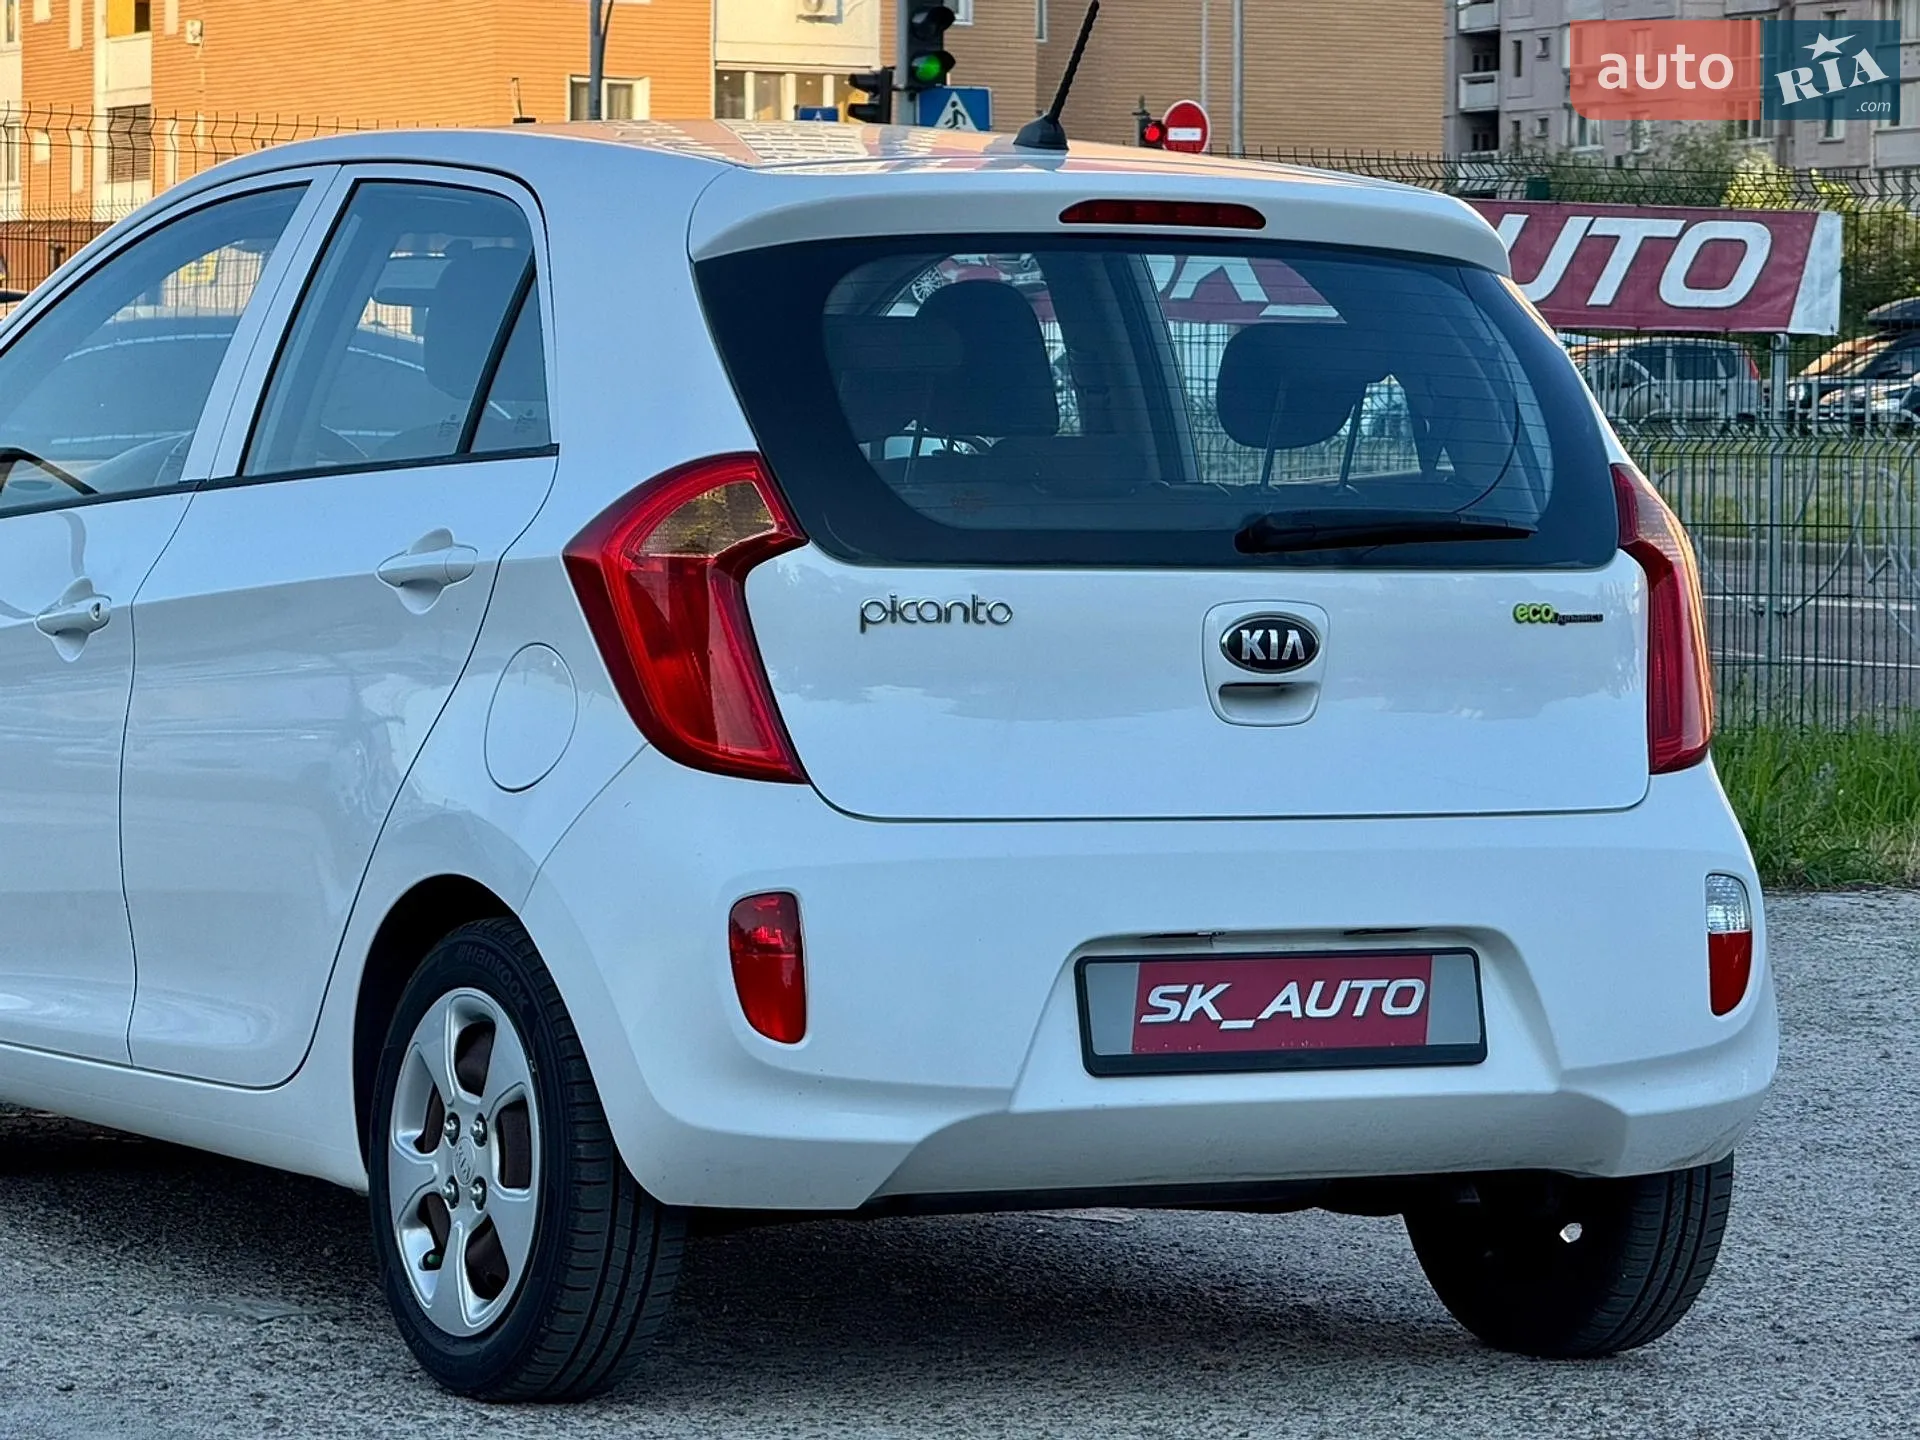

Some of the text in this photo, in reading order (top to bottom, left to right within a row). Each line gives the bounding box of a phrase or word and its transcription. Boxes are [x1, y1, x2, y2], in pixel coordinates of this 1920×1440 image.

[1497, 213, 1772, 308] UTO
[860, 592, 1013, 634] picanto
[1240, 628, 1306, 660] KIA
[1140, 978, 1426, 1030] SK_AUTO
